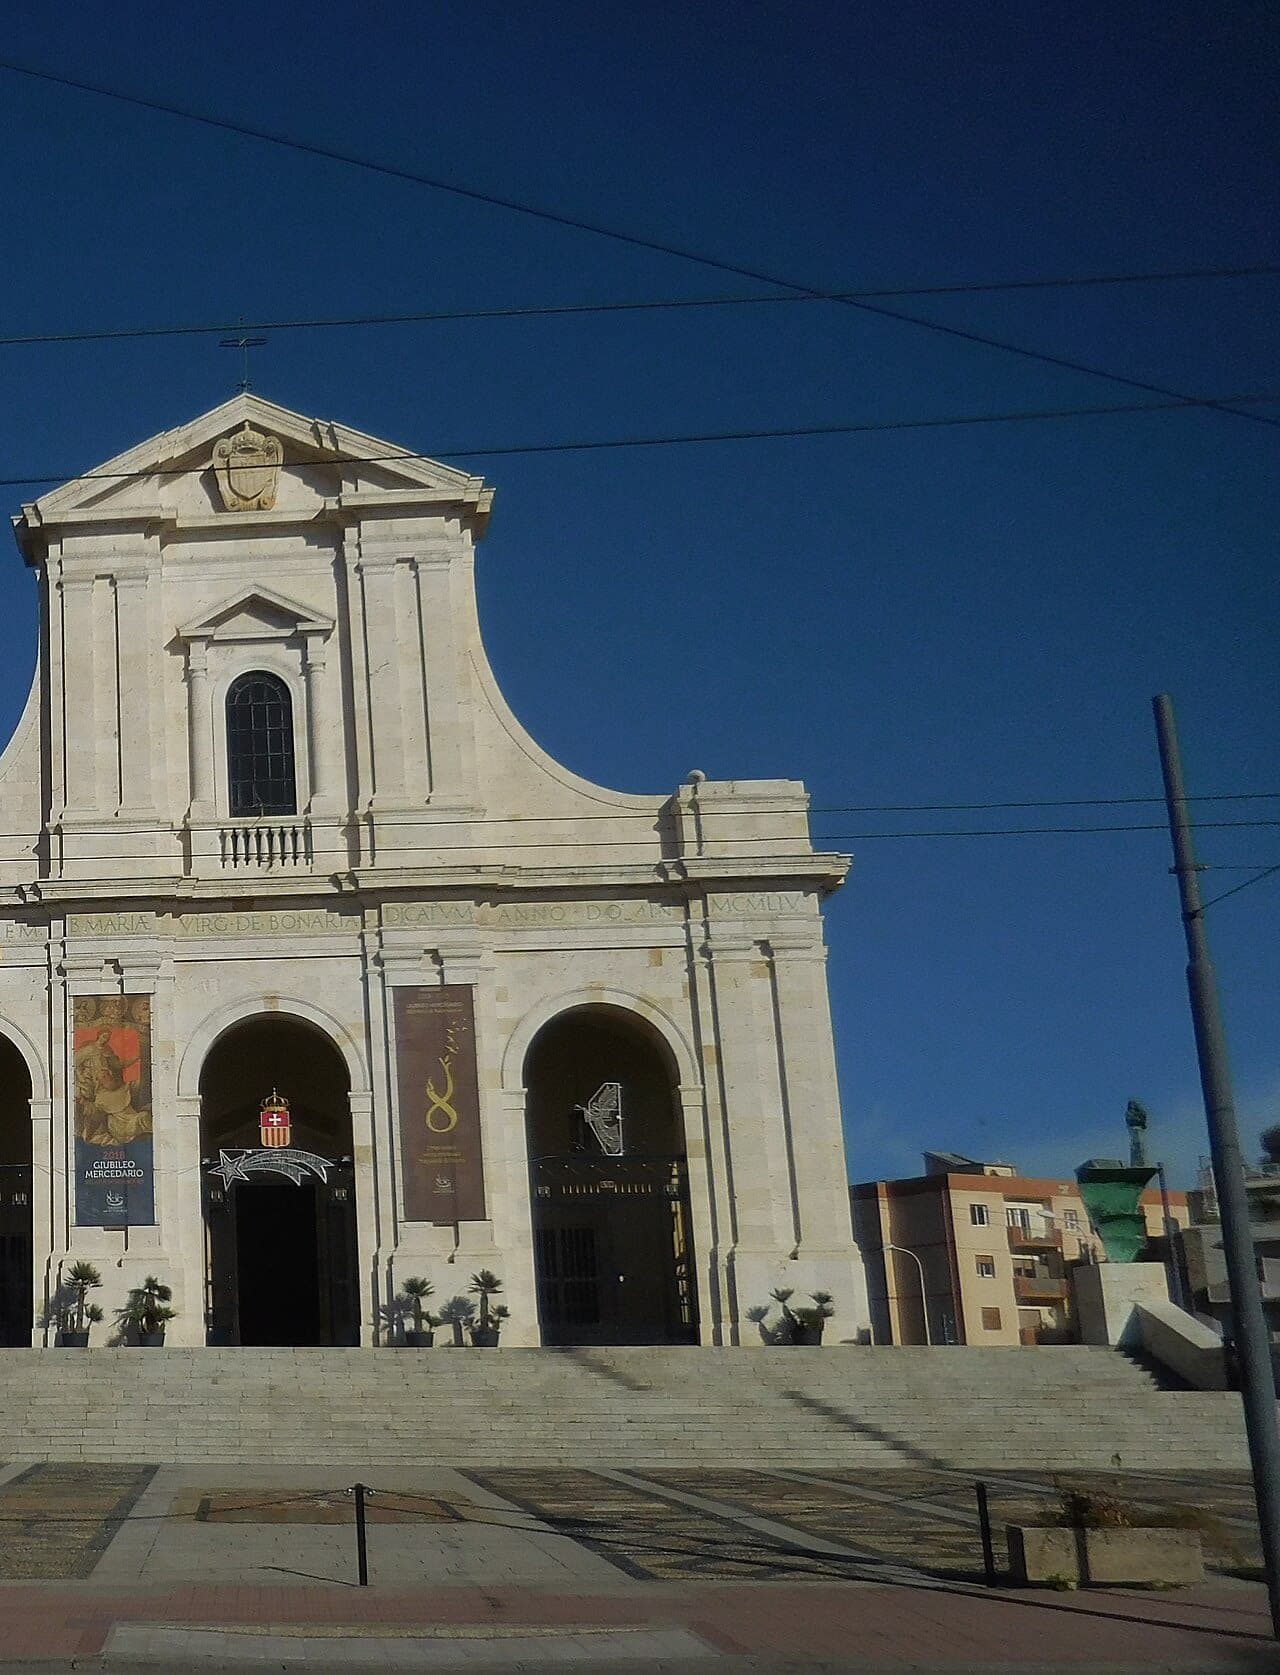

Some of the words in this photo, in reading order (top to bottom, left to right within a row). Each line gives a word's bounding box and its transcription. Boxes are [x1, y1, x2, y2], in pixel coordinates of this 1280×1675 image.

[269, 912, 359, 931] BONARIA
[93, 1160, 136, 1169] GIUBILEO
[84, 1169, 144, 1178] MERCEDARIO
